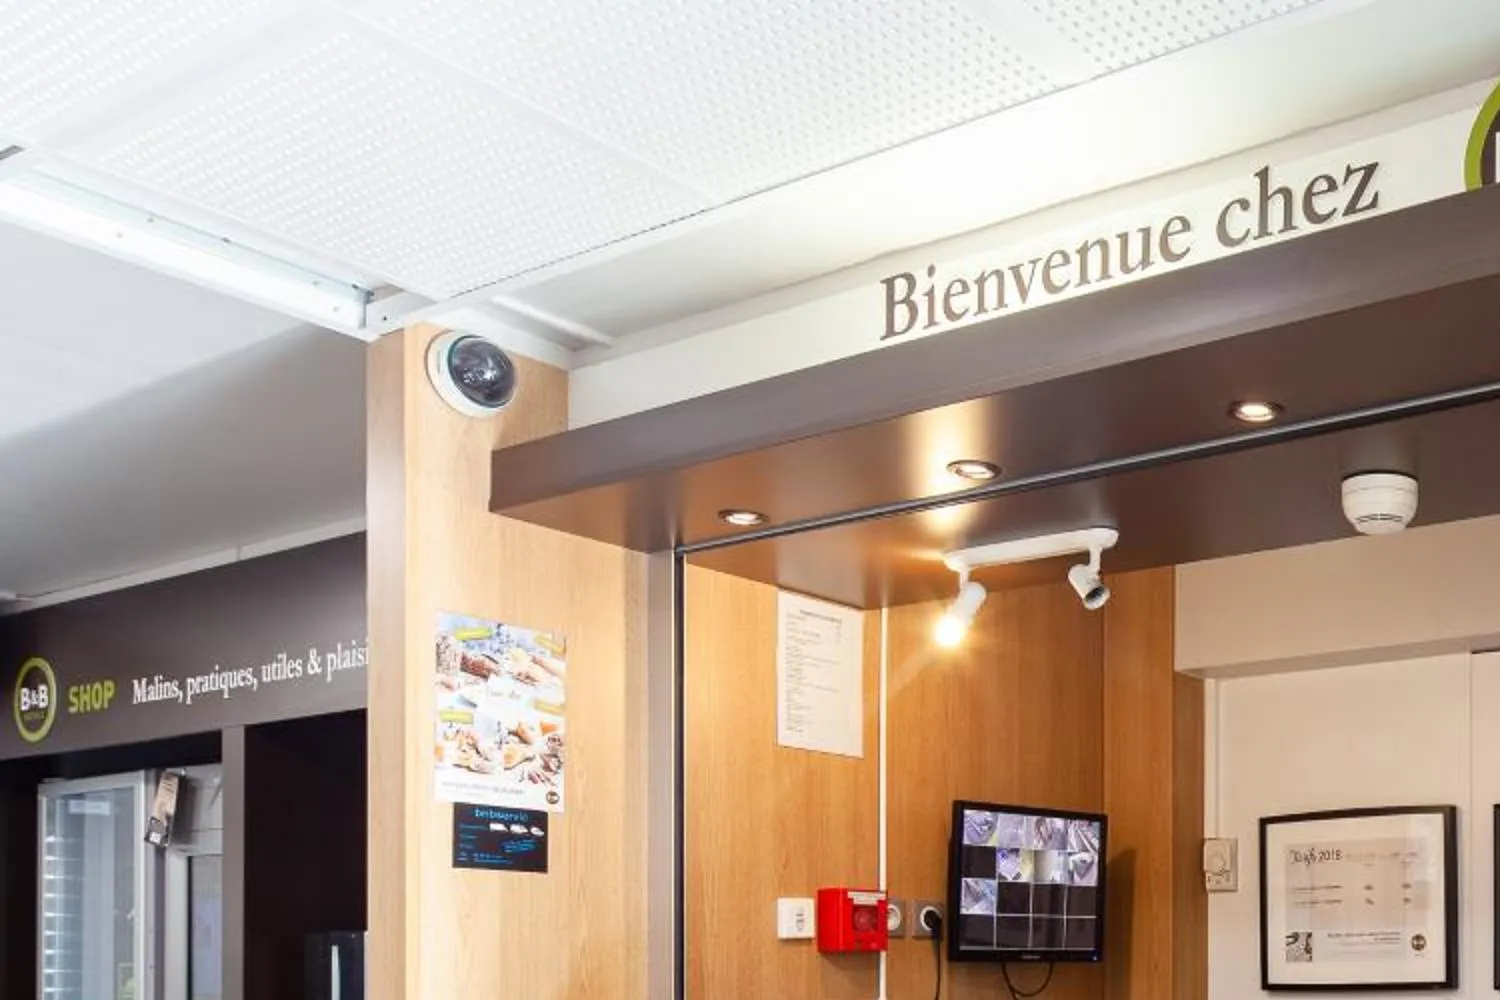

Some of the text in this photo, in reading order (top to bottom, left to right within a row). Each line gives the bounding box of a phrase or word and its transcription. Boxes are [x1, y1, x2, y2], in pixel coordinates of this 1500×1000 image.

[879, 215, 1193, 342] Bienvenue
[1215, 160, 1381, 248] chez
[20, 684, 48, 711] B&B
[68, 679, 115, 713] SHOP
[131, 675, 184, 705] Malins,
[185, 664, 259, 705] pratiques,
[261, 652, 303, 684] utiles
[306, 647, 322, 675] &
